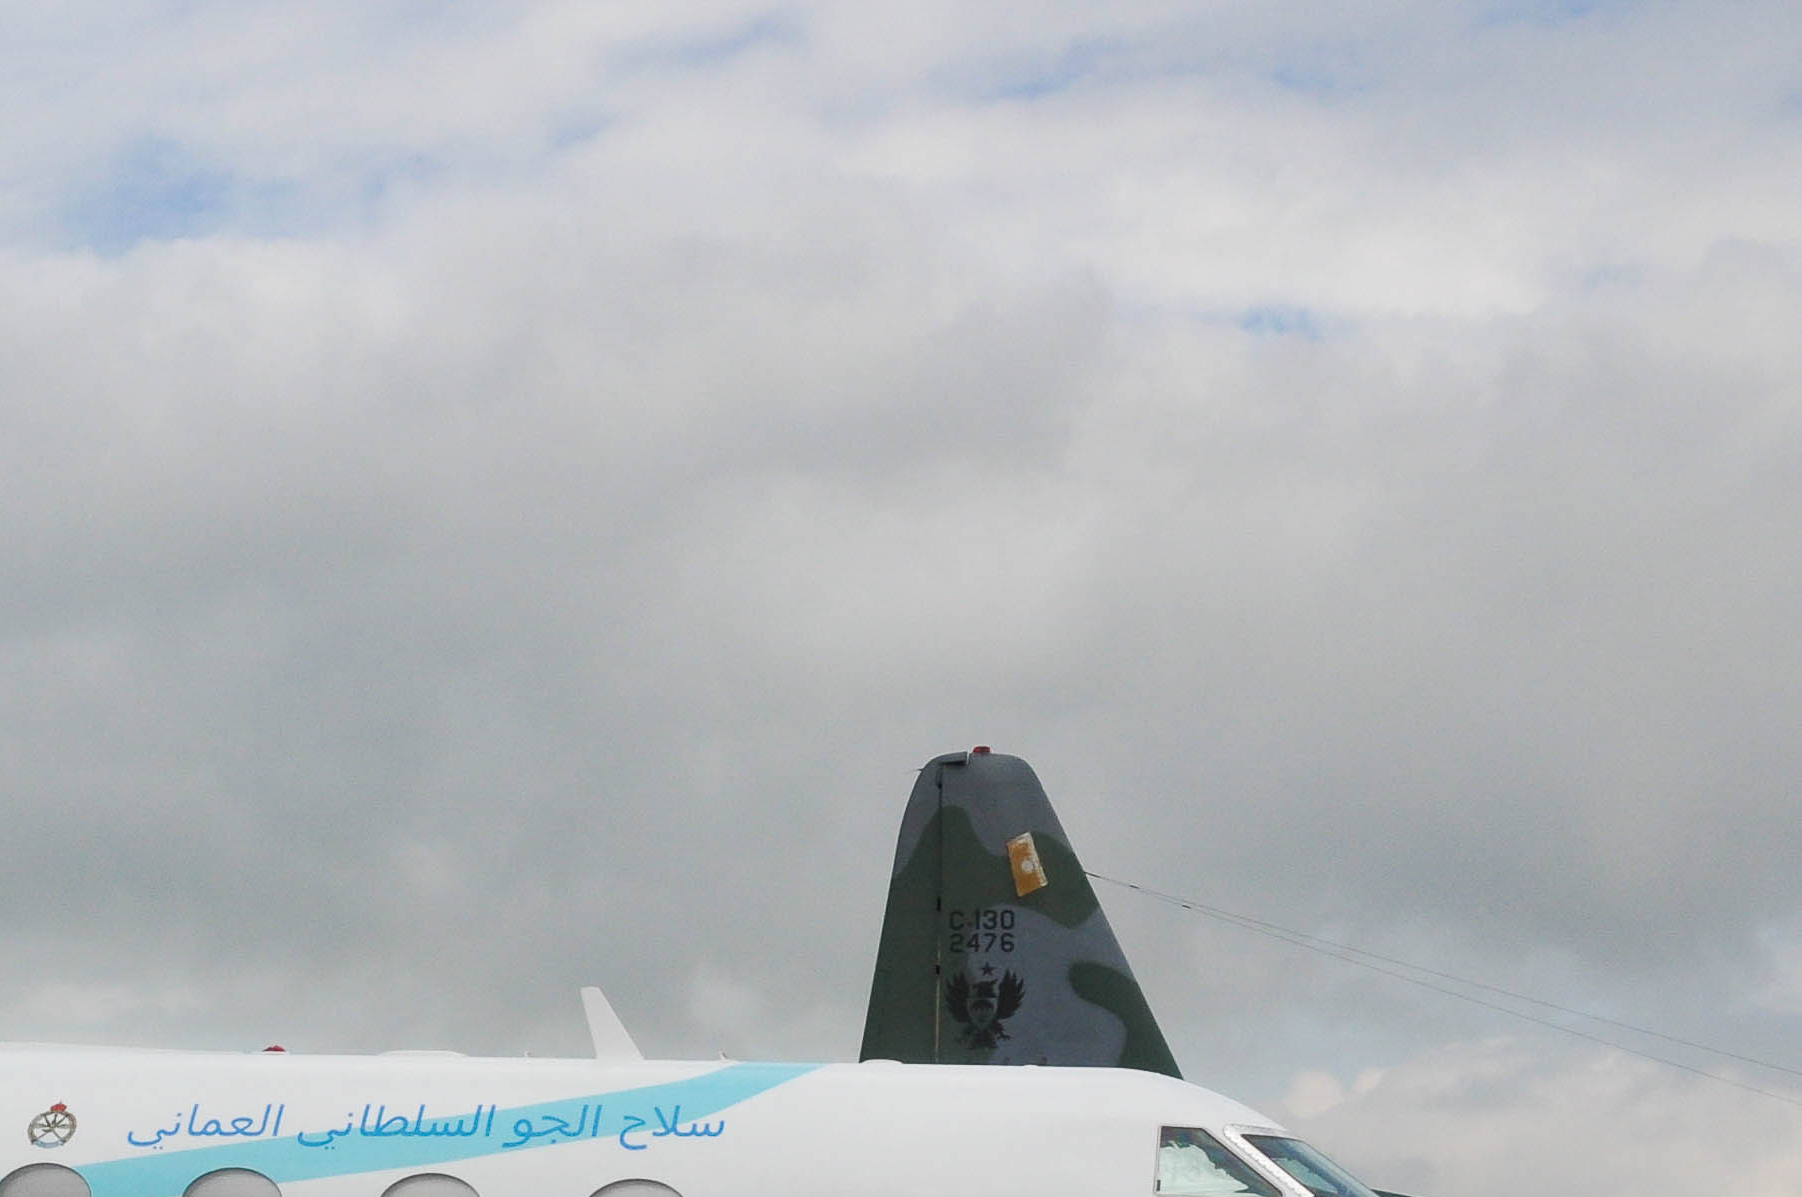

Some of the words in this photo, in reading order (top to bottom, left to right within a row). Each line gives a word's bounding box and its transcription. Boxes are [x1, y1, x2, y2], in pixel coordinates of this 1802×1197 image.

[949, 932, 1015, 953] 2476
[127, 1102, 285, 1150] العماني
[297, 1103, 496, 1150] السلطاني
[501, 1104, 603, 1149] الجو
[619, 1104, 725, 1150] سلاح
